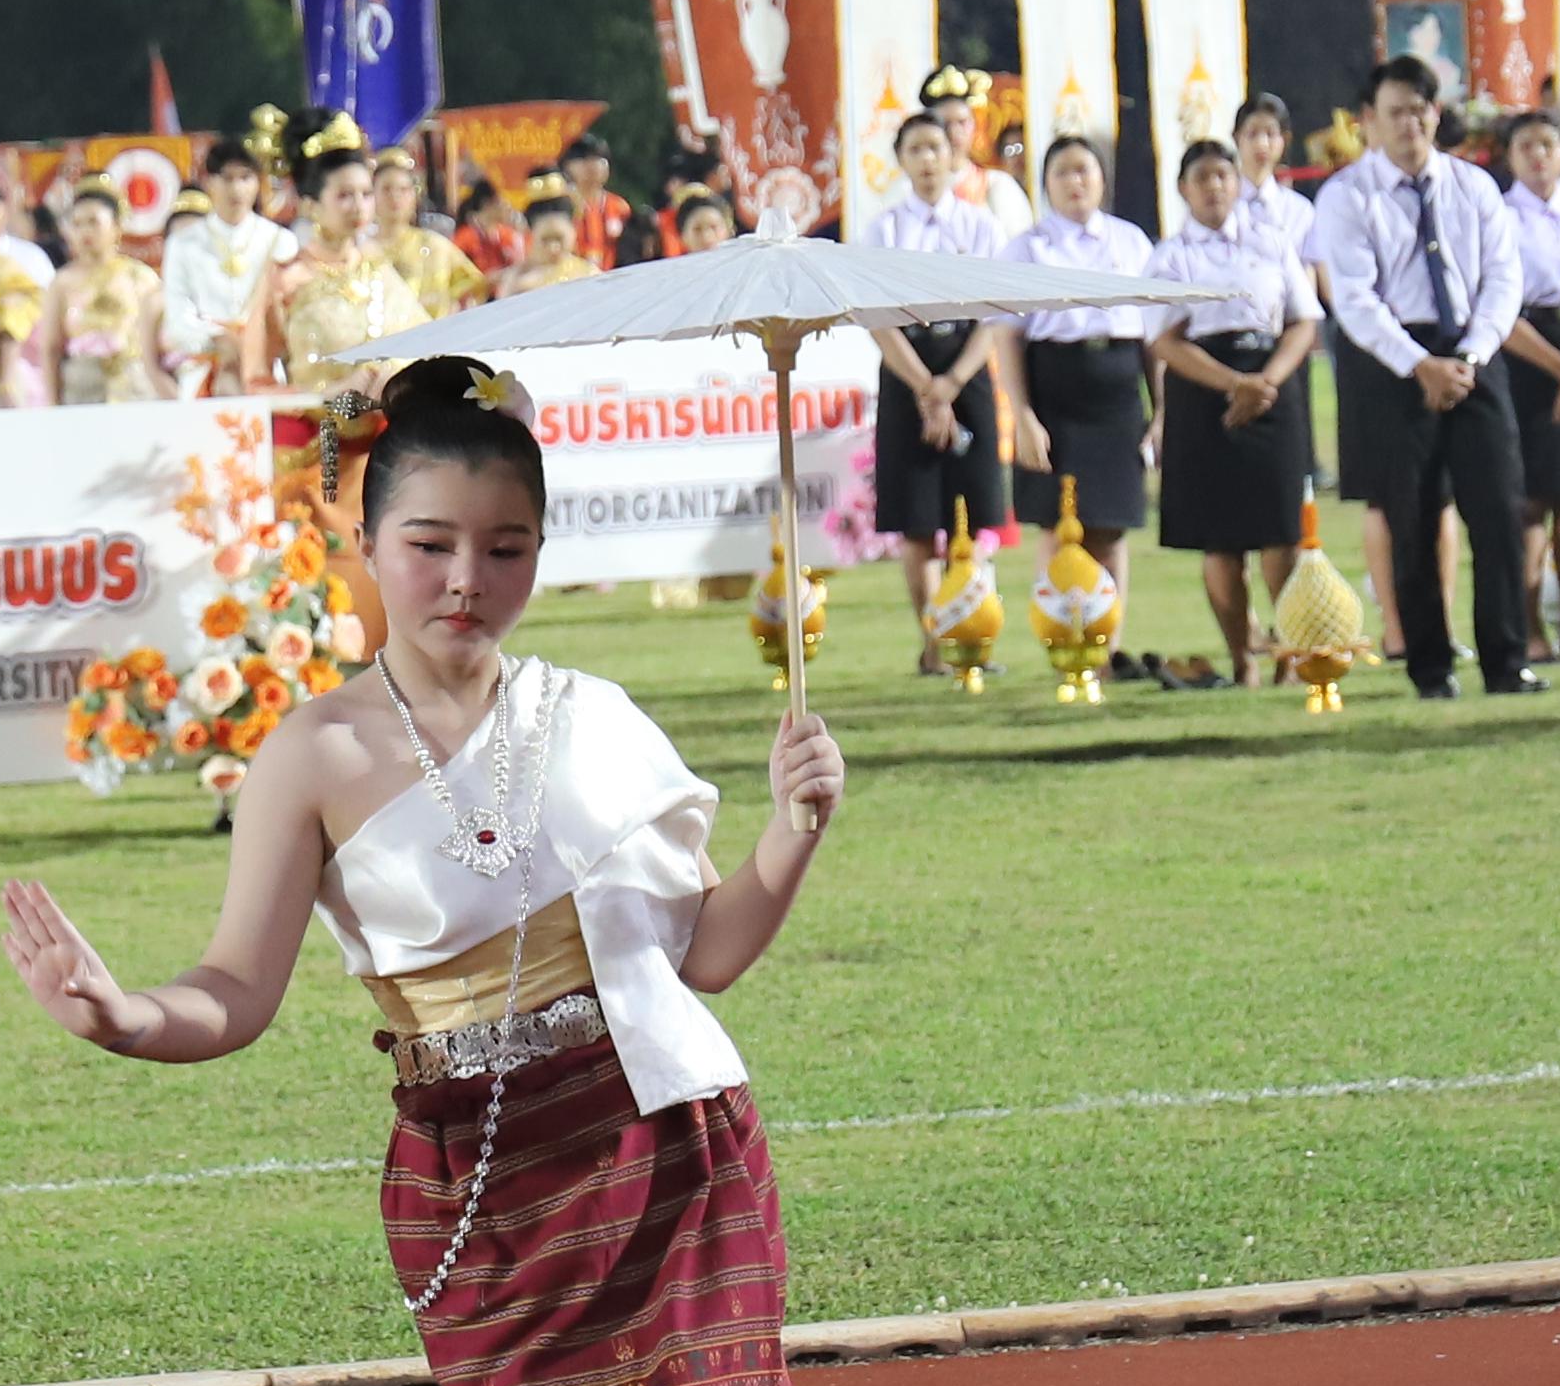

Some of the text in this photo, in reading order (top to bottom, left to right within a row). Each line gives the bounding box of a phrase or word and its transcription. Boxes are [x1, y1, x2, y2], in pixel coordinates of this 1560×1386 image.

[532, 376, 864, 446] รบริหารนักศึกษา
[586, 484, 825, 525] ORGANIZATIN
